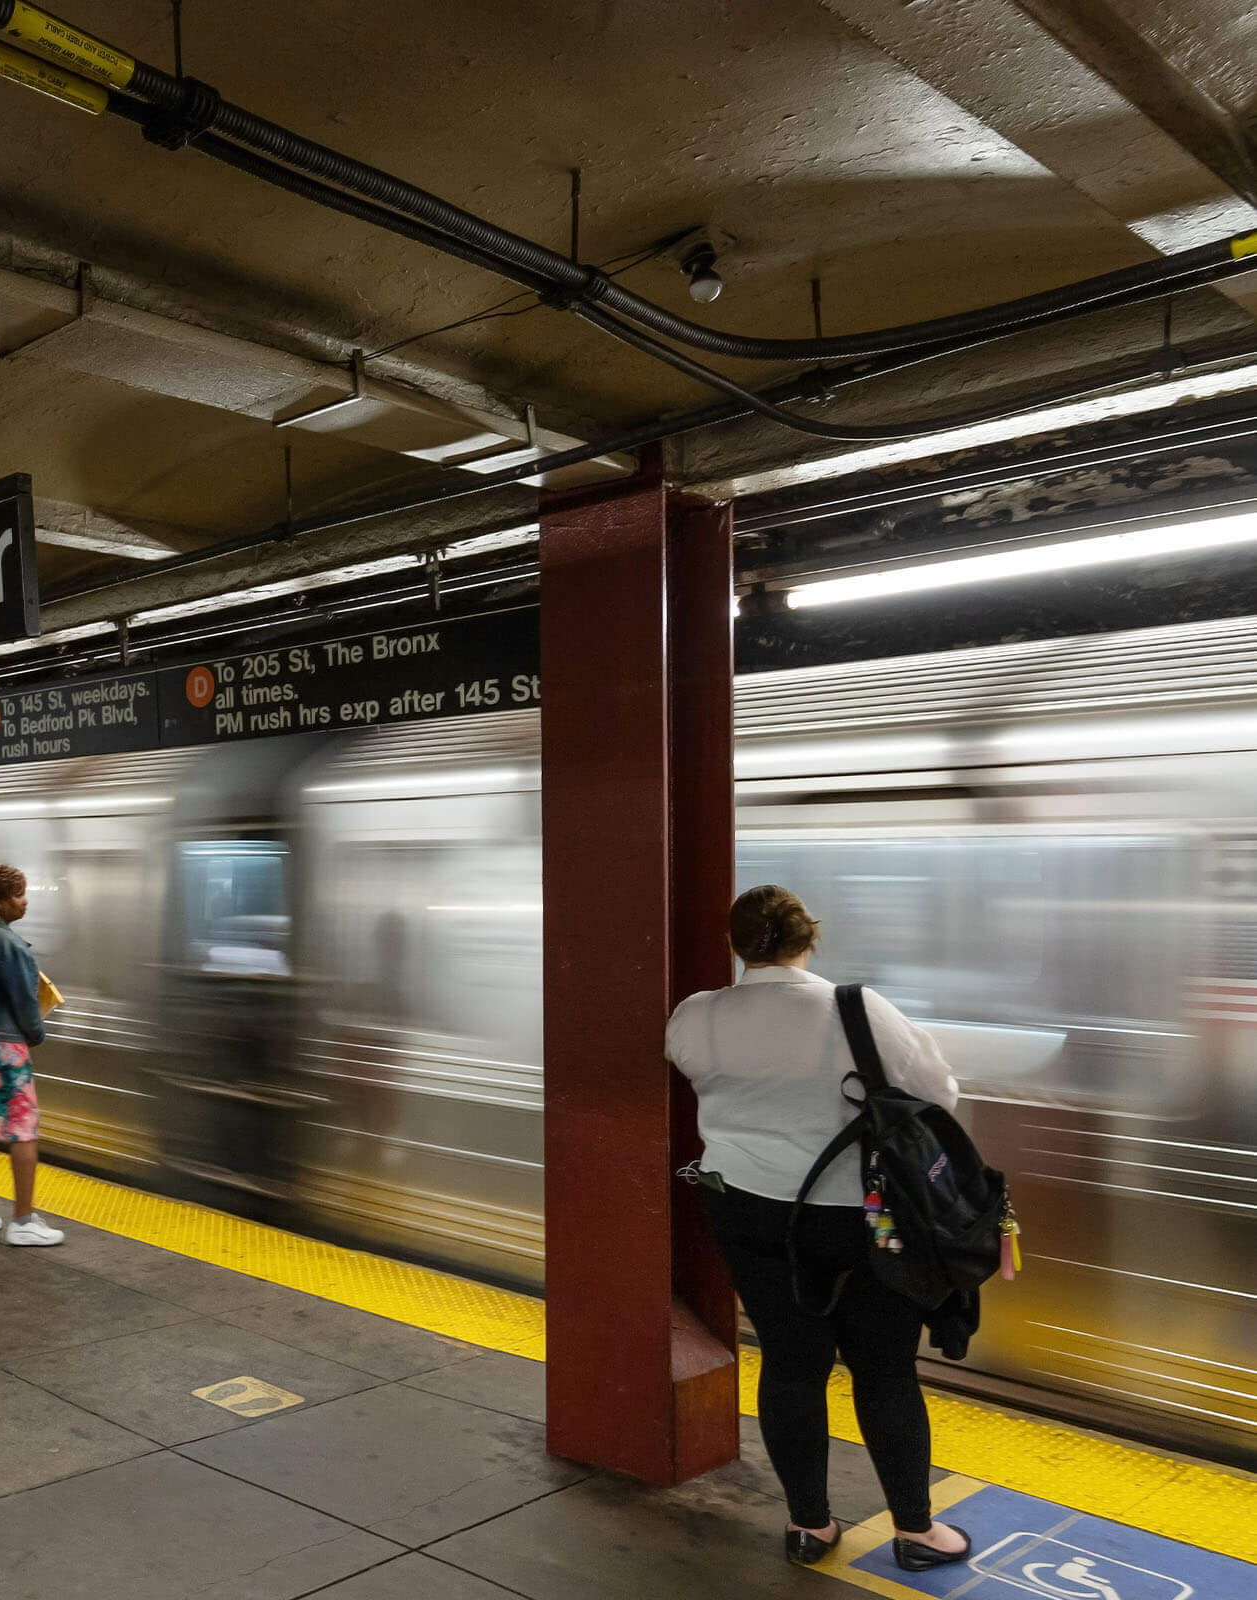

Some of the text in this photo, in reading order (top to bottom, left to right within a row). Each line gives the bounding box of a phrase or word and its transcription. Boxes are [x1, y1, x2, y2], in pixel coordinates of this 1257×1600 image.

[214, 631, 441, 684] To 205 St, The Bronx
[1, 680, 150, 717] To 145 St, weekdays.
[215, 682, 299, 710] all times.
[216, 674, 542, 736] PM rush hrs exp after 145 St
[1, 702, 138, 738] To Bedford Pk Blvd,
[2, 736, 71, 759] rush hours
